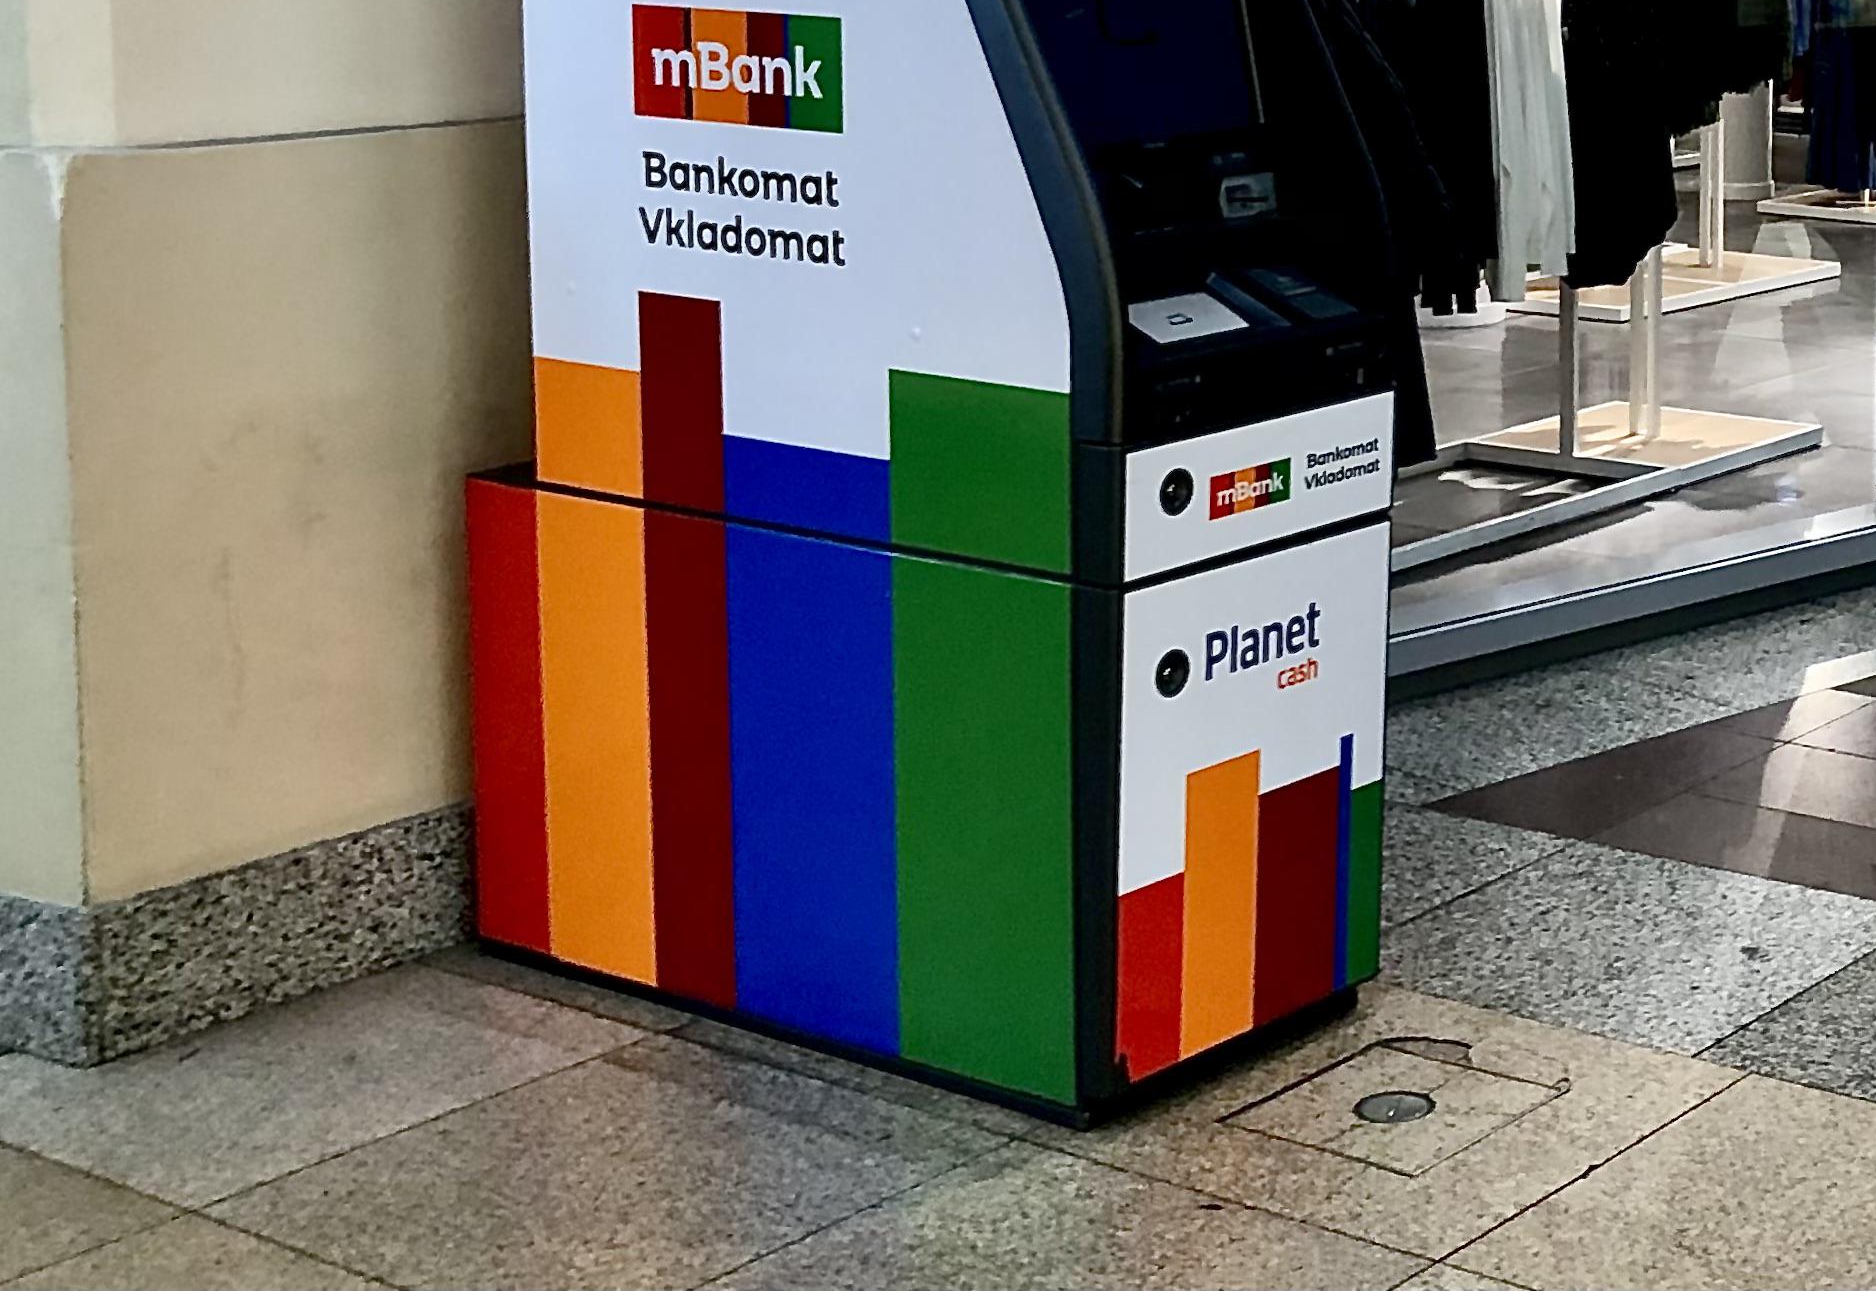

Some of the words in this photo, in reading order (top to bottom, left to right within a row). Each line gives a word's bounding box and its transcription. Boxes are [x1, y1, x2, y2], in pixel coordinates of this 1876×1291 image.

[652, 41, 824, 99] mBank
[643, 150, 839, 207] Bankomat
[638, 206, 846, 267] Vkladomat
[1304, 458, 1380, 490] Vkladomat
[1306, 437, 1380, 469] Bankomat
[1216, 471, 1284, 507] mBank
[1205, 602, 1321, 682] Planet
[1277, 657, 1319, 689] cash
